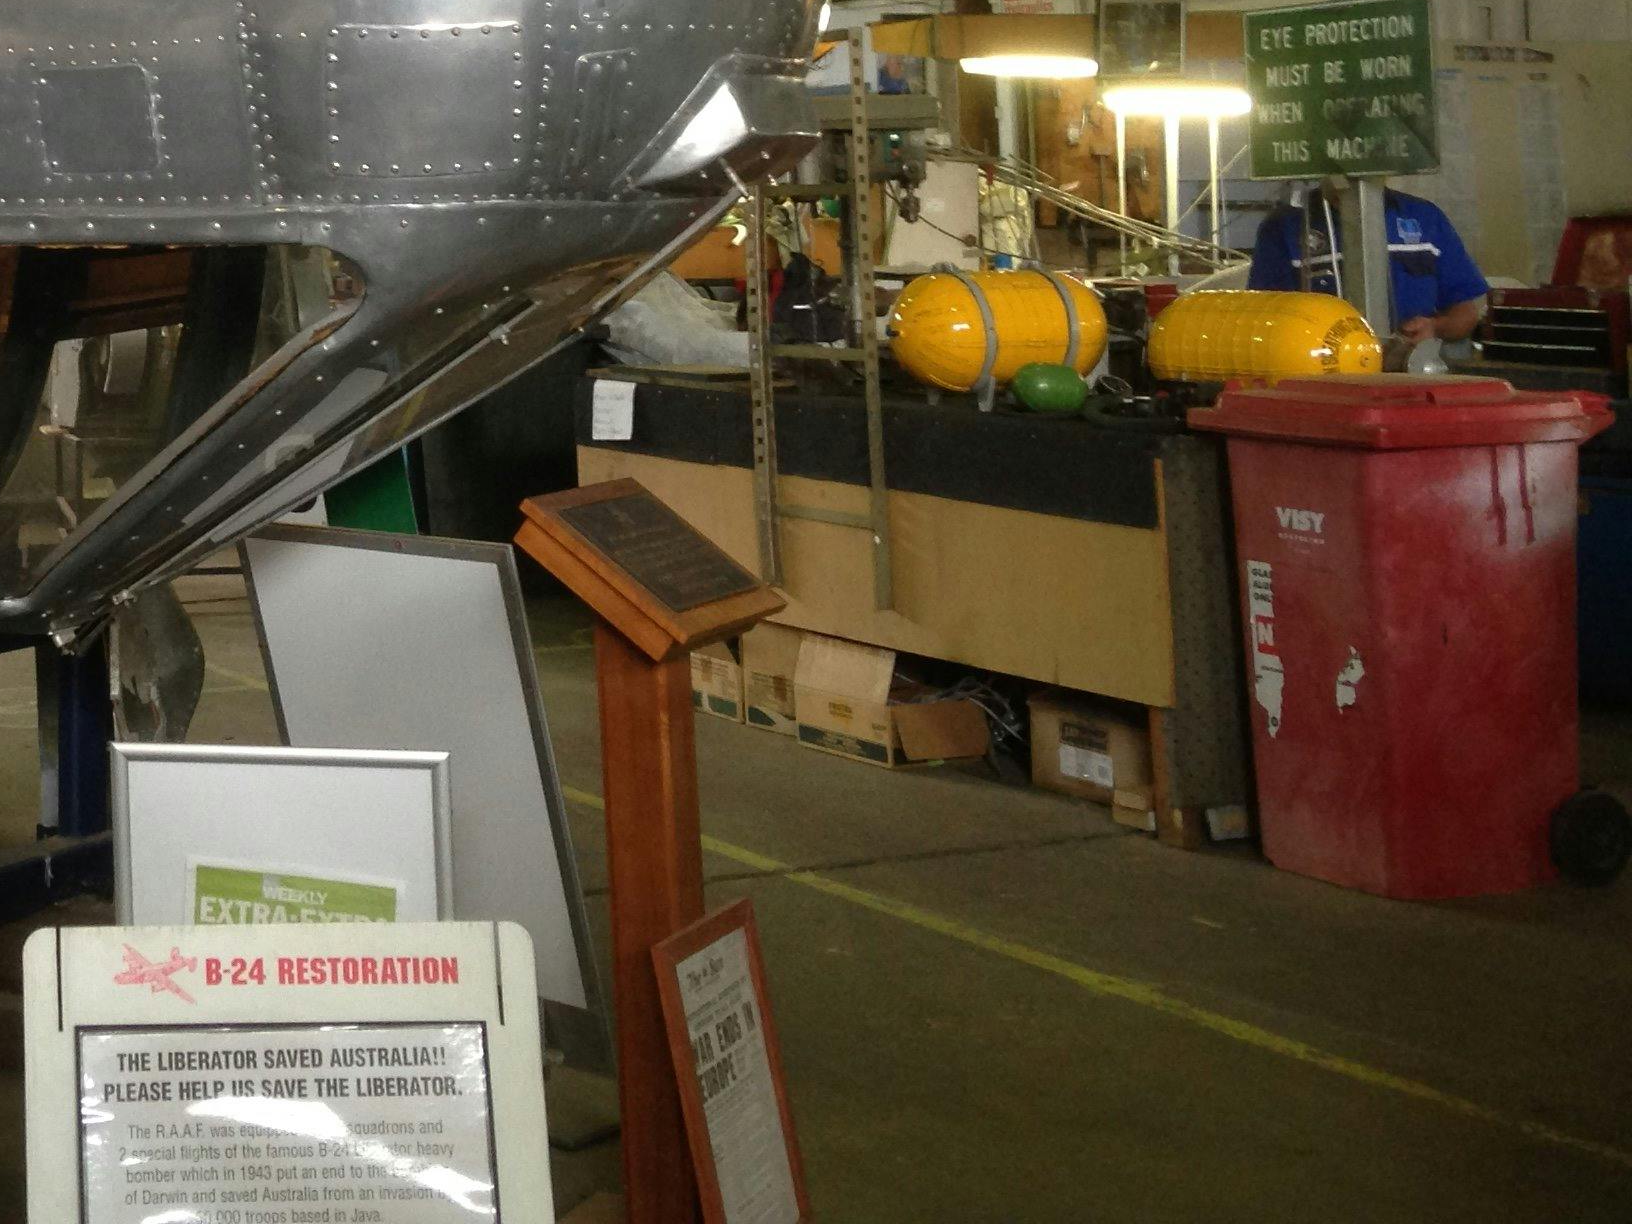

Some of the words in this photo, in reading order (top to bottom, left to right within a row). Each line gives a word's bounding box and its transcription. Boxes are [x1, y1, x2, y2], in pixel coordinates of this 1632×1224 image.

[1259, 25, 1294, 51] EYE
[1304, 14, 1416, 48] PROTECTION
[1265, 62, 1312, 88] MUST
[1323, 60, 1347, 84] BE
[1359, 54, 1412, 81] WORN
[1255, 101, 1305, 126] WHEN
[1271, 140, 1311, 164] THIS
[1325, 134, 1410, 161] MACHNE
[205, 957, 266, 986] B-24
[276, 956, 459, 986] RESTORATION
[117, 1052, 151, 1072] THE
[157, 1049, 257, 1072] LIBERATOR
[264, 1048, 323, 1069] SAVED
[330, 1046, 446, 1068] AUSTRALIA!!
[104, 1082, 172, 1103] PLEASE
[179, 1080, 225, 1101] HELP
[232, 1079, 256, 1098] US
[261, 1078, 307, 1099] SAVE
[315, 1078, 350, 1098] THE
[356, 1076, 463, 1098] LIBERATOR.
[128, 1125, 151, 1140] The
[210, 1126, 235, 1138] was
[419, 1120, 443, 1135] and
[119, 1146, 127, 1162] 2
[181, 1144, 221, 1163] flights
[225, 1144, 238, 1159] of
[242, 1144, 262, 1159] the
[266, 1142, 315, 1159] famous
[416, 1141, 455, 1158] heavy
[126, 1168, 176, 1184] bomber
[180, 1167, 219, 1182] which
[223, 1167, 236, 1181] in
[240, 1165, 272, 1182] 1943
[276, 1165, 298, 1183] put
[302, 1167, 318, 1179] an
[321, 1165, 346, 1180] end
[350, 1165, 364, 1179] to
[368, 1164, 387, 1179] the
[124, 1189, 138, 1206] of
[142, 1188, 189, 1205] Darwin
[192, 1187, 216, 1204] and
[220, 1187, 258, 1203] saved
[262, 1185, 318, 1203] Australia
[322, 1186, 355, 1201] from
[358, 1187, 374, 1200] an
[291, 1208, 334, 1224] based
[334, 1209, 347, 1224] in
